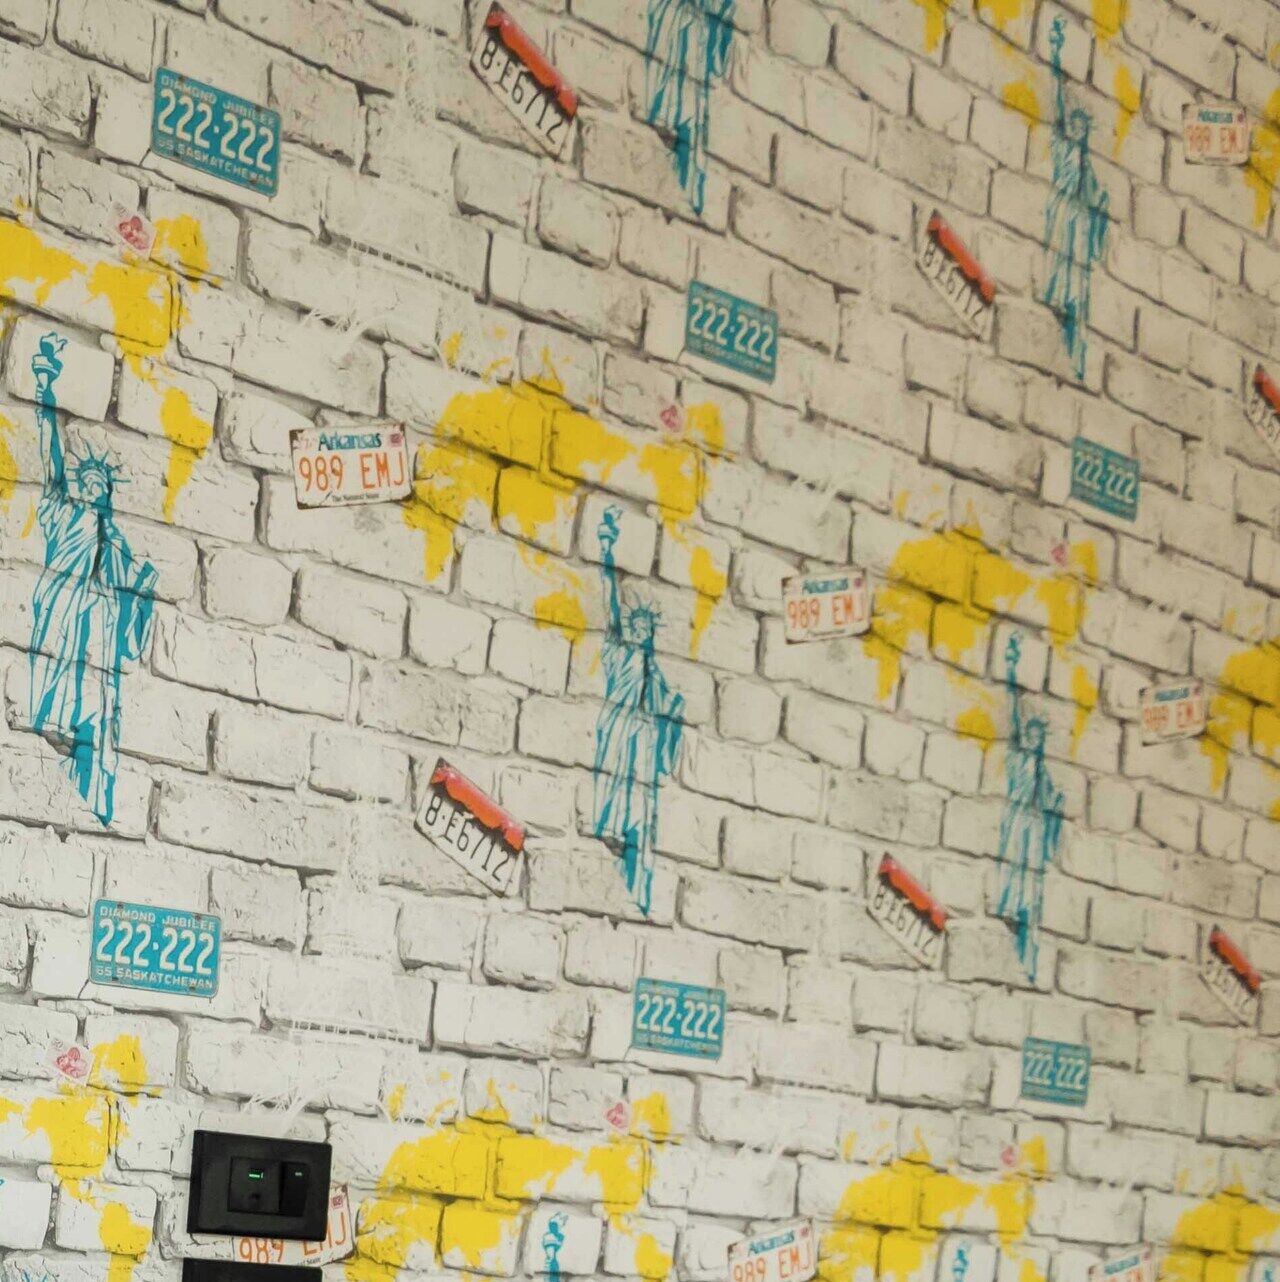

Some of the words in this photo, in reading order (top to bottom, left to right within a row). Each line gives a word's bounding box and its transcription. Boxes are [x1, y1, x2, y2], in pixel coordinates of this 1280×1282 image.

[299, 454, 344, 491] 989
[359, 451, 404, 489] EMJ
[100, 906, 156, 923] DIAMOND
[161, 915, 216, 932] JUBILEE
[116, 966, 213, 989] SASKATCHEWAN
